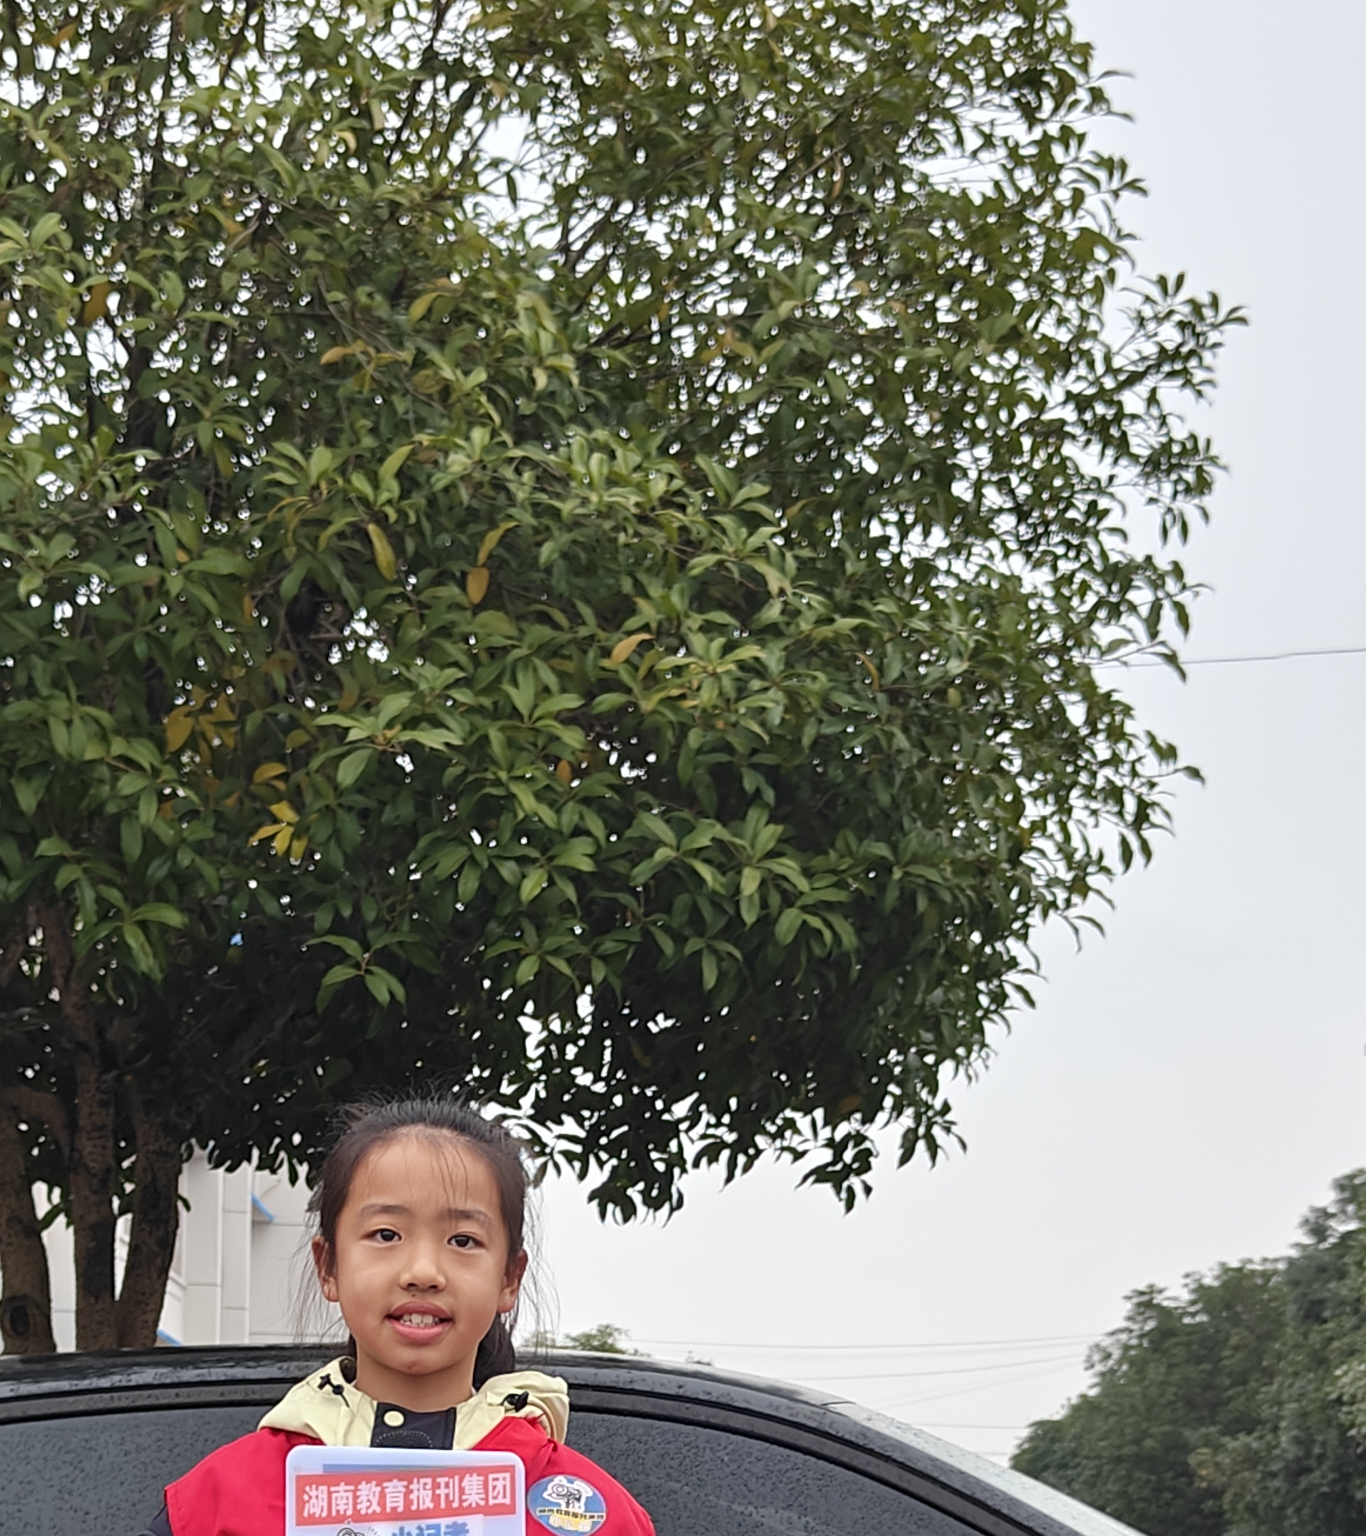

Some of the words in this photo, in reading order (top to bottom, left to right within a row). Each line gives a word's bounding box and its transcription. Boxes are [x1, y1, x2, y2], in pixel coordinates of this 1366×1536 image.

[302, 1471, 512, 1518] 湖南教育报刊集团
